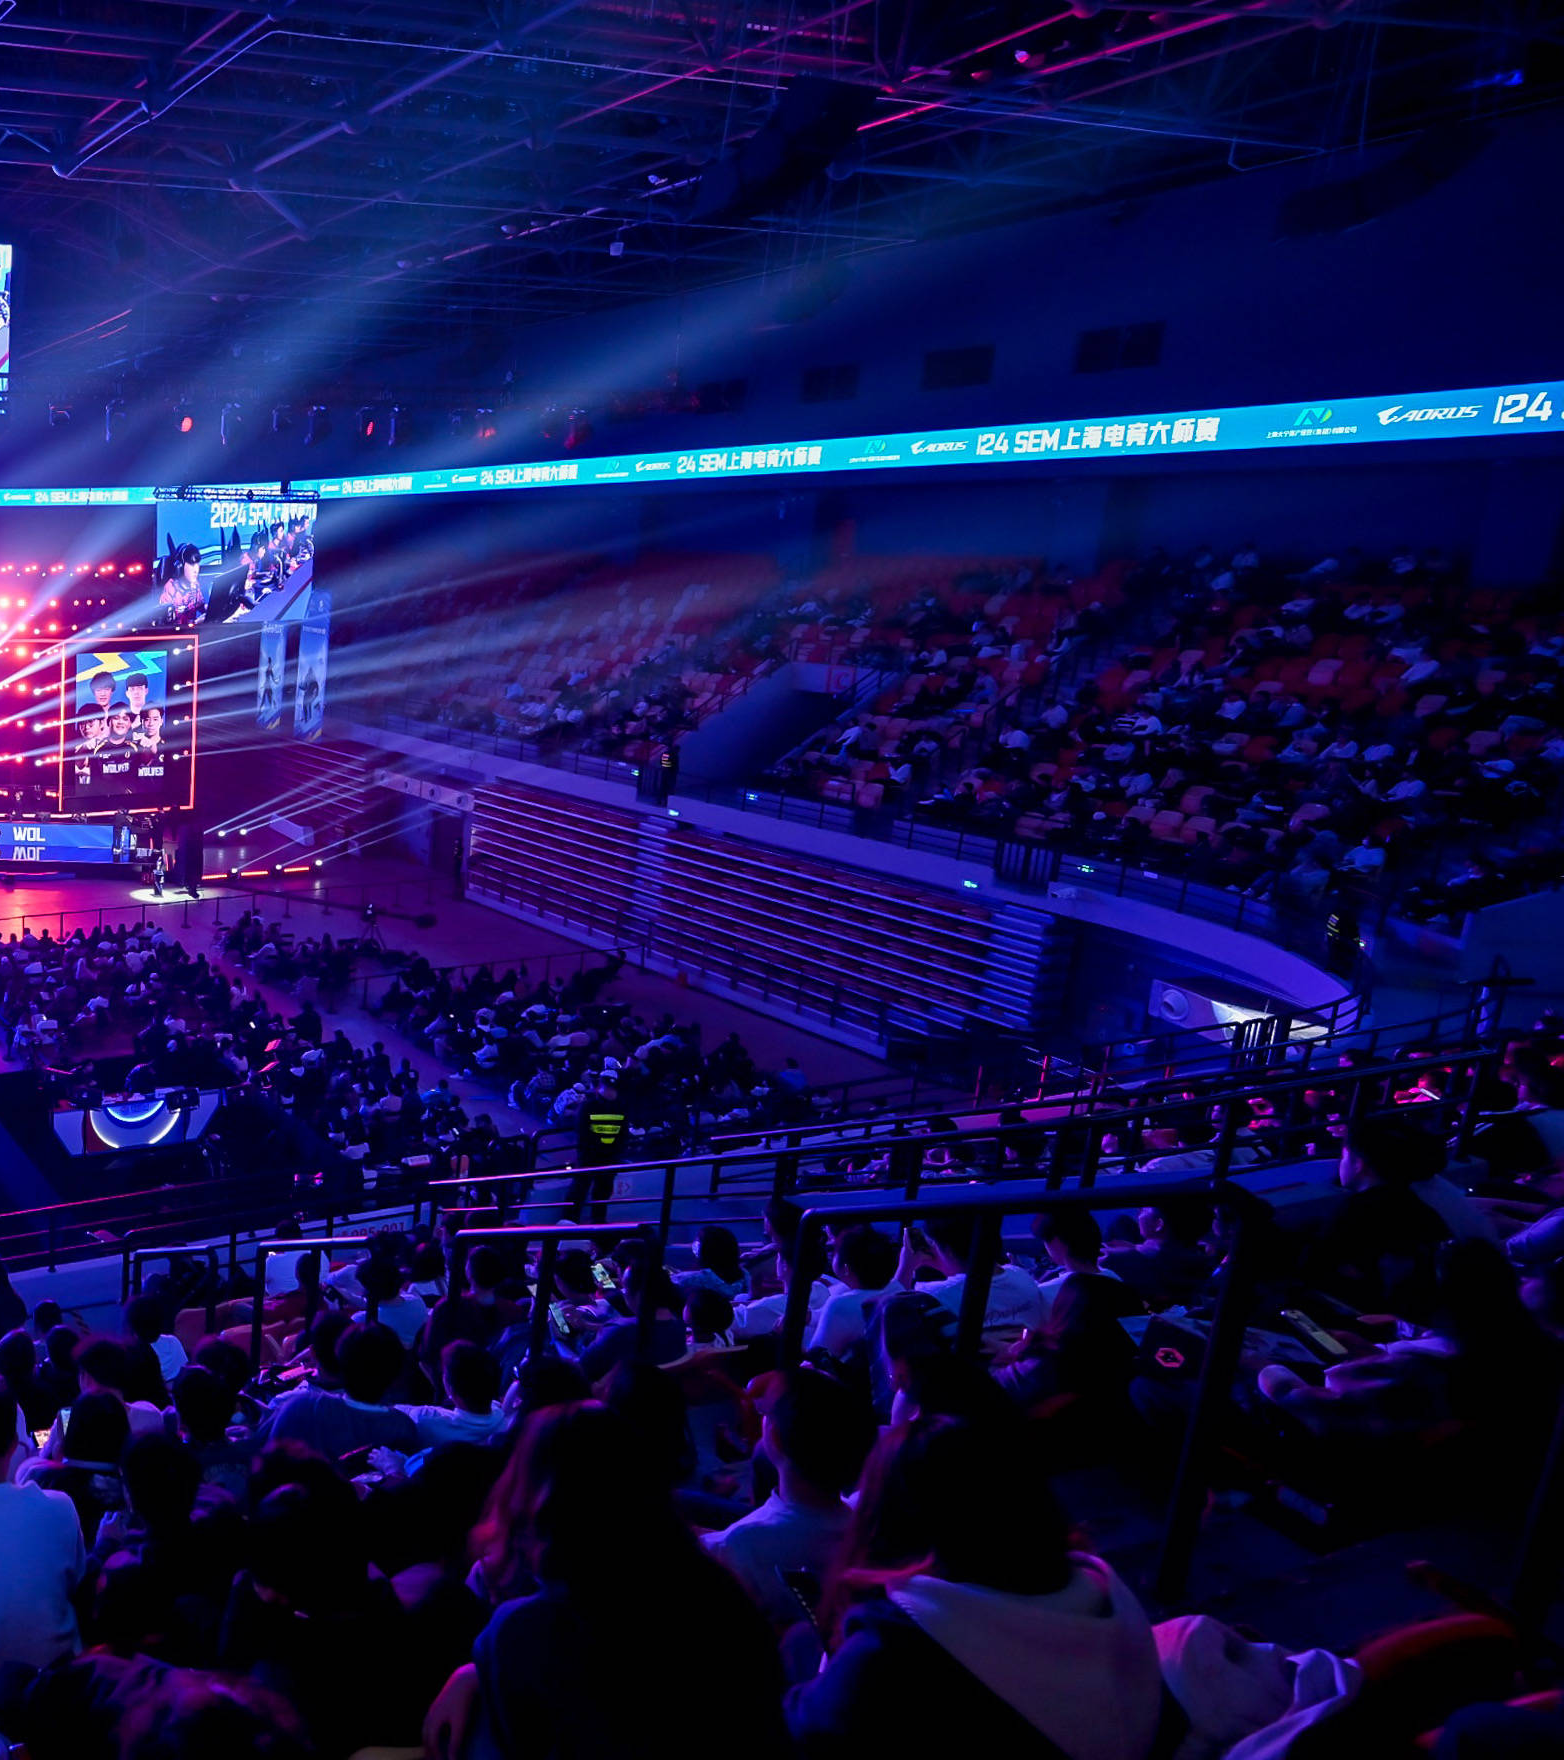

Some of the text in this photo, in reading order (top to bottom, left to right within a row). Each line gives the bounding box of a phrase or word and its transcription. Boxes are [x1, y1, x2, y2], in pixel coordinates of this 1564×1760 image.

[1394, 404, 1484, 423] AORUS
[1492, 391, 1552, 425] 24
[976, 432, 1009, 456] 24
[210, 502, 247, 529] 2024
[12, 826, 46, 842] WOL
